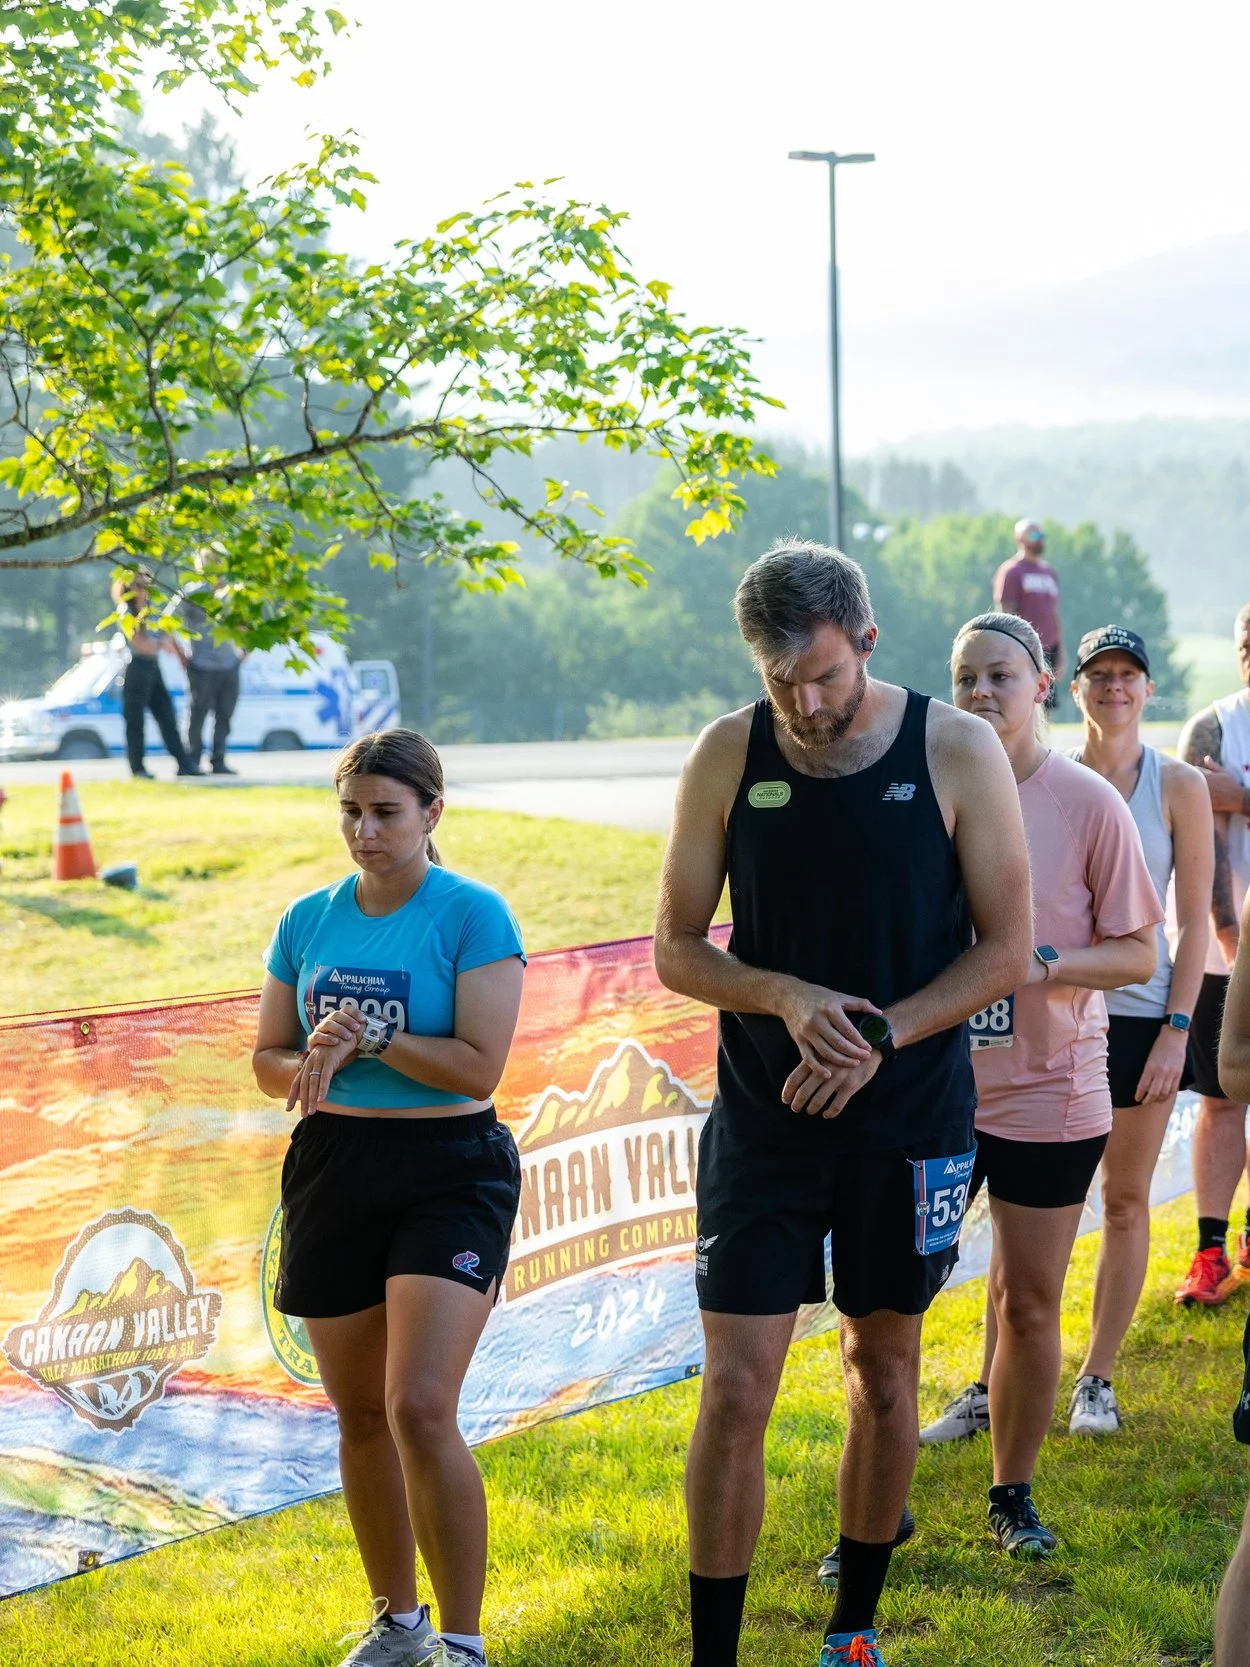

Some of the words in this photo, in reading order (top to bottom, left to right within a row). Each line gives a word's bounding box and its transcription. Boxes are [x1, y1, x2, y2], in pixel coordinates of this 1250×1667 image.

[328, 968, 386, 986] APPALACHIAN
[338, 982, 363, 994] Timing
[364, 984, 391, 996] Group
[511, 1143, 613, 1244] NAAN
[932, 1179, 971, 1227] 53
[513, 1234, 610, 1292] RUNNING
[19, 1315, 124, 1367] CANAAN
[133, 1295, 210, 1348] VALLEY
[570, 1279, 667, 1348] 2024
[39, 1360, 68, 1383] HALF
[70, 1352, 139, 1376] MARATHON
[141, 1348, 164, 1363] 10K
[167, 1345, 177, 1359] &
[179, 1341, 195, 1357] 5K
[278, 1329, 320, 1374] TRA
